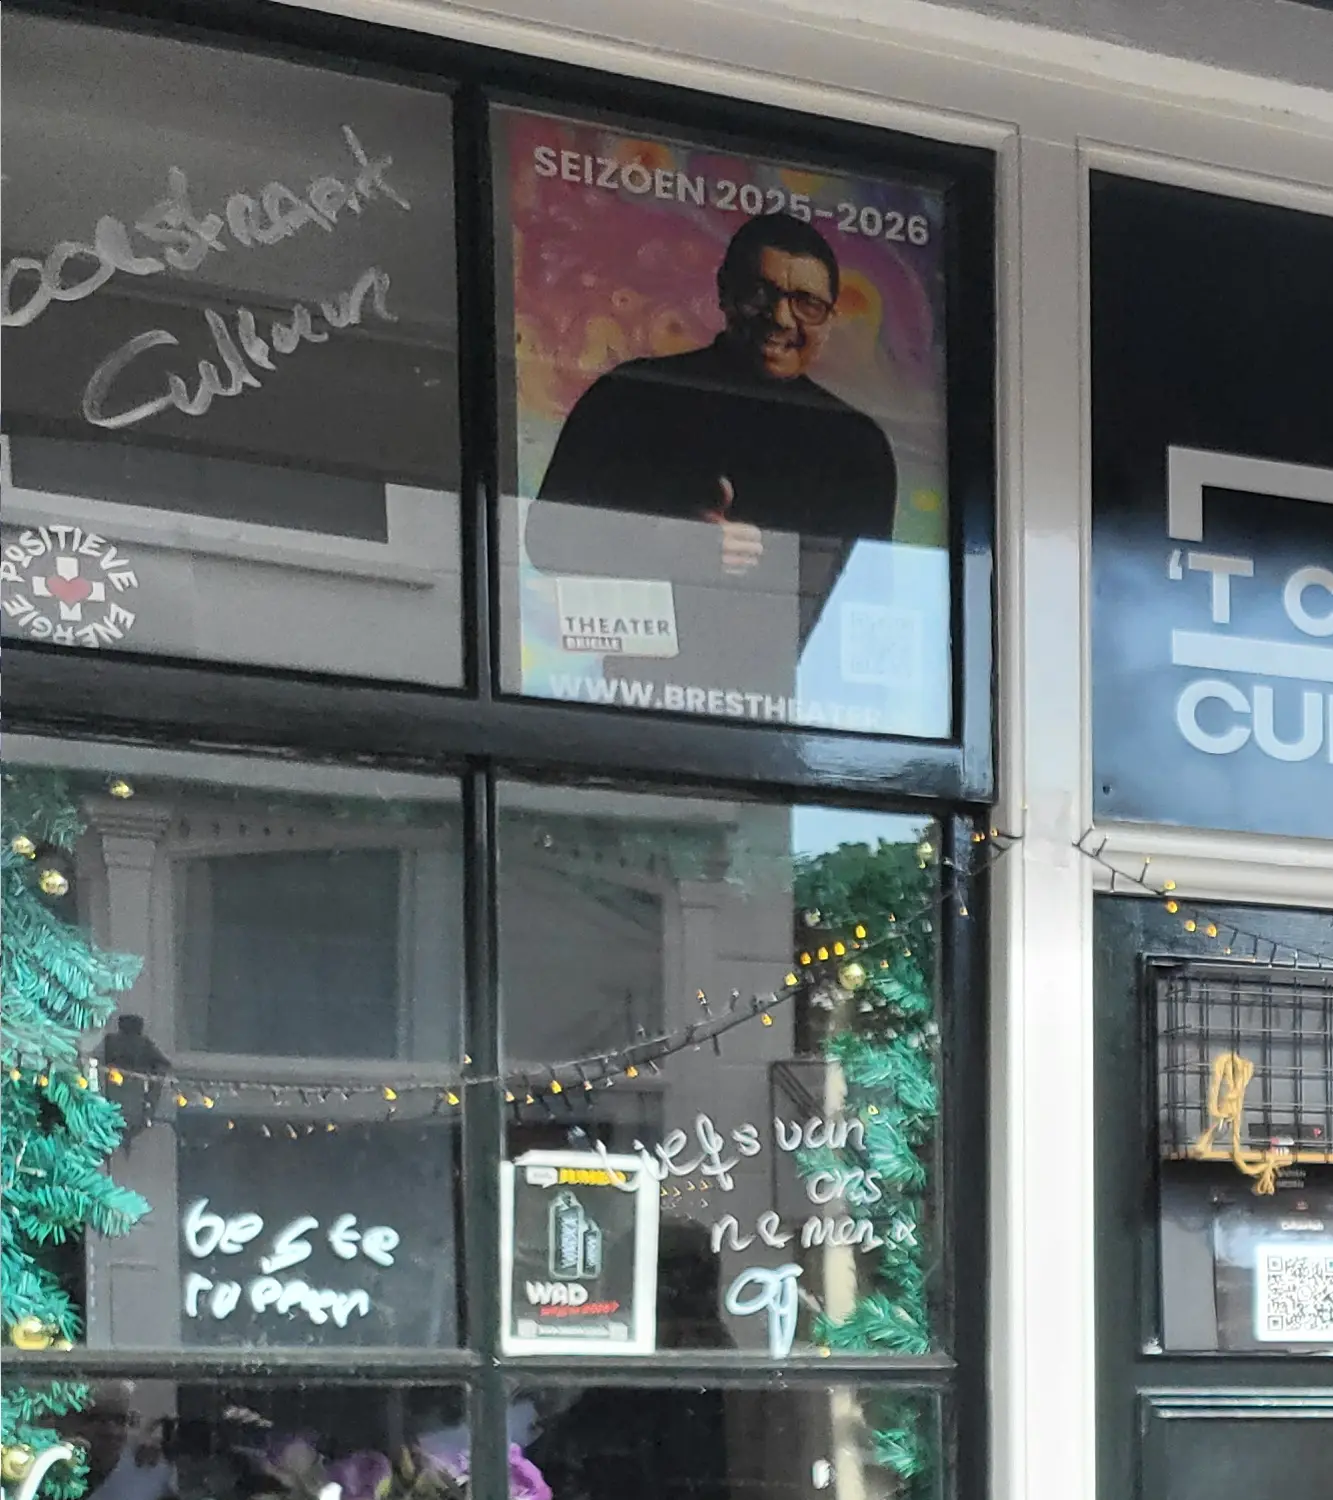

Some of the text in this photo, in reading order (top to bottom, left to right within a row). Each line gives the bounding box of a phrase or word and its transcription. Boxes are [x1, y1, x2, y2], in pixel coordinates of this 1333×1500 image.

[533, 145, 930, 246] SEIZOEN 2025-2026
[0, 525, 139, 592] POSITIEVE
[3, 602, 136, 648] ENERGIE
[564, 616, 670, 636] THEATER
[526, 1280, 588, 1306] WAD
